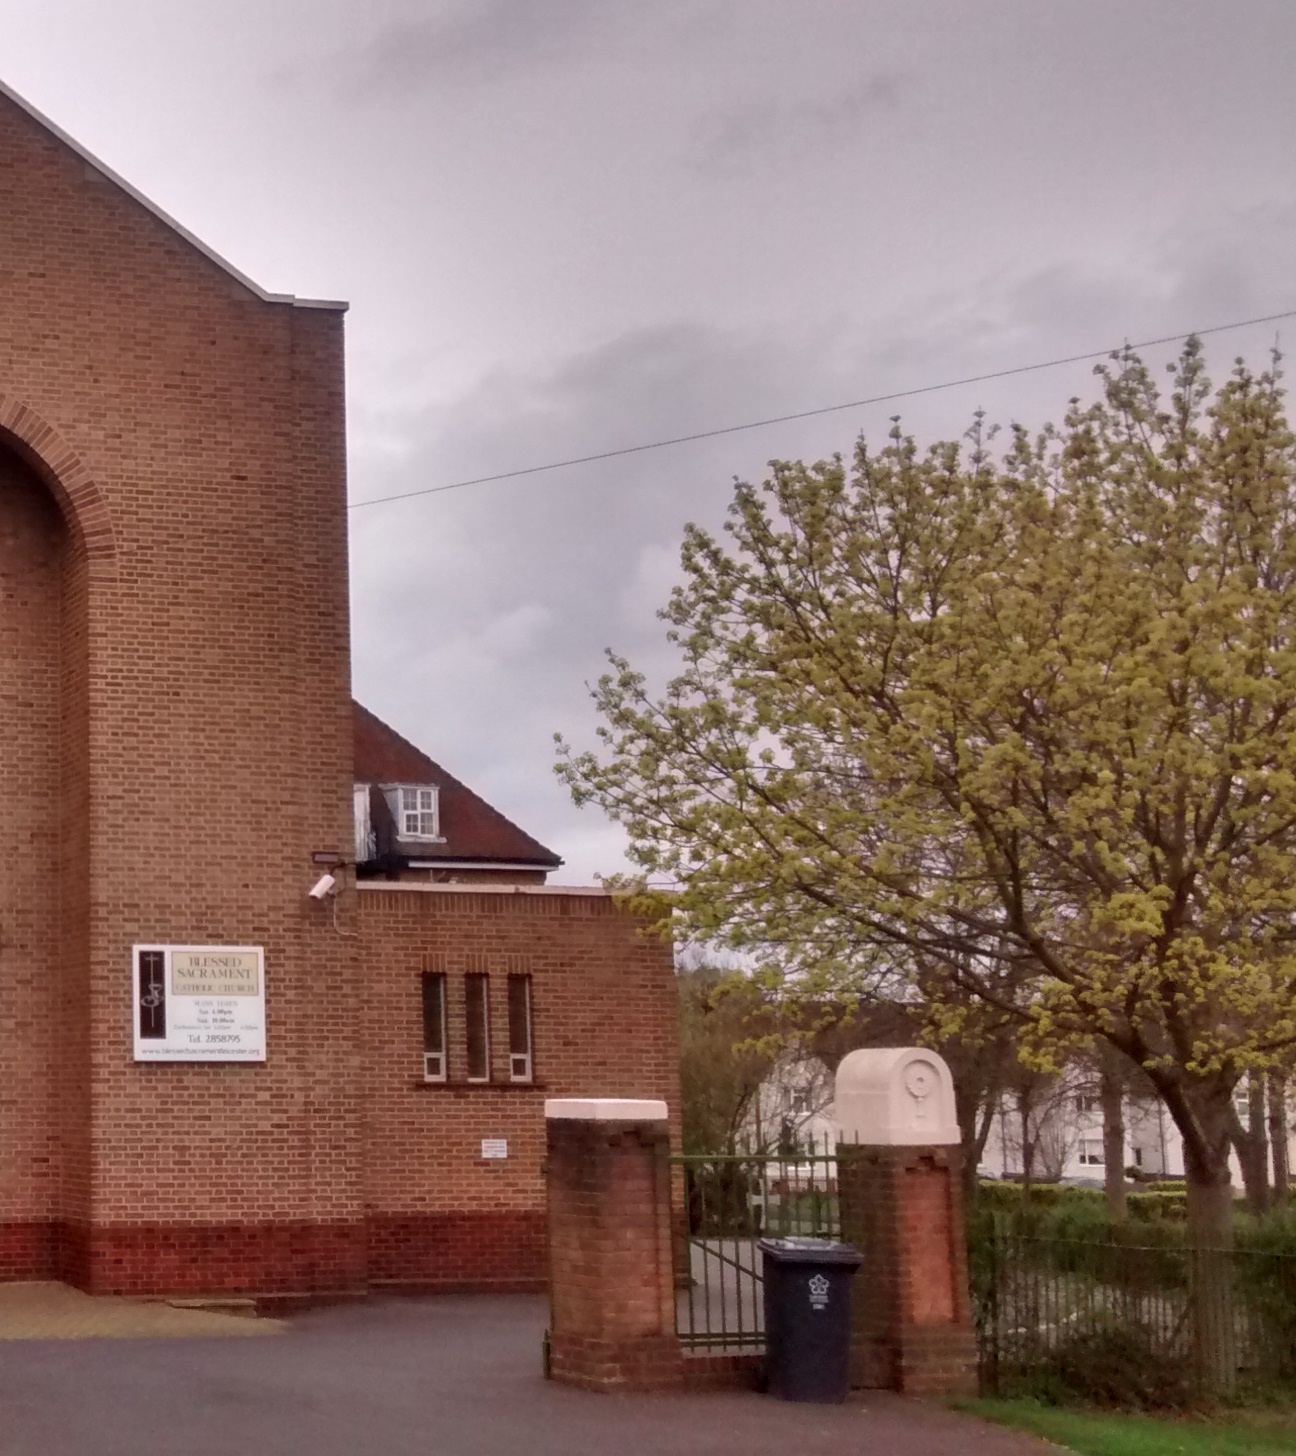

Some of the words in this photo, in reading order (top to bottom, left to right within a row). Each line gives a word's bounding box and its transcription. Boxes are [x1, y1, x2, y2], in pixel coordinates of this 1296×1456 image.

[189, 956, 242, 968] BLESSED
[177, 968, 251, 979] SACRAMENT
[176, 983, 213, 993] CATHOLIC
[218, 983, 255, 993] CHURCH
